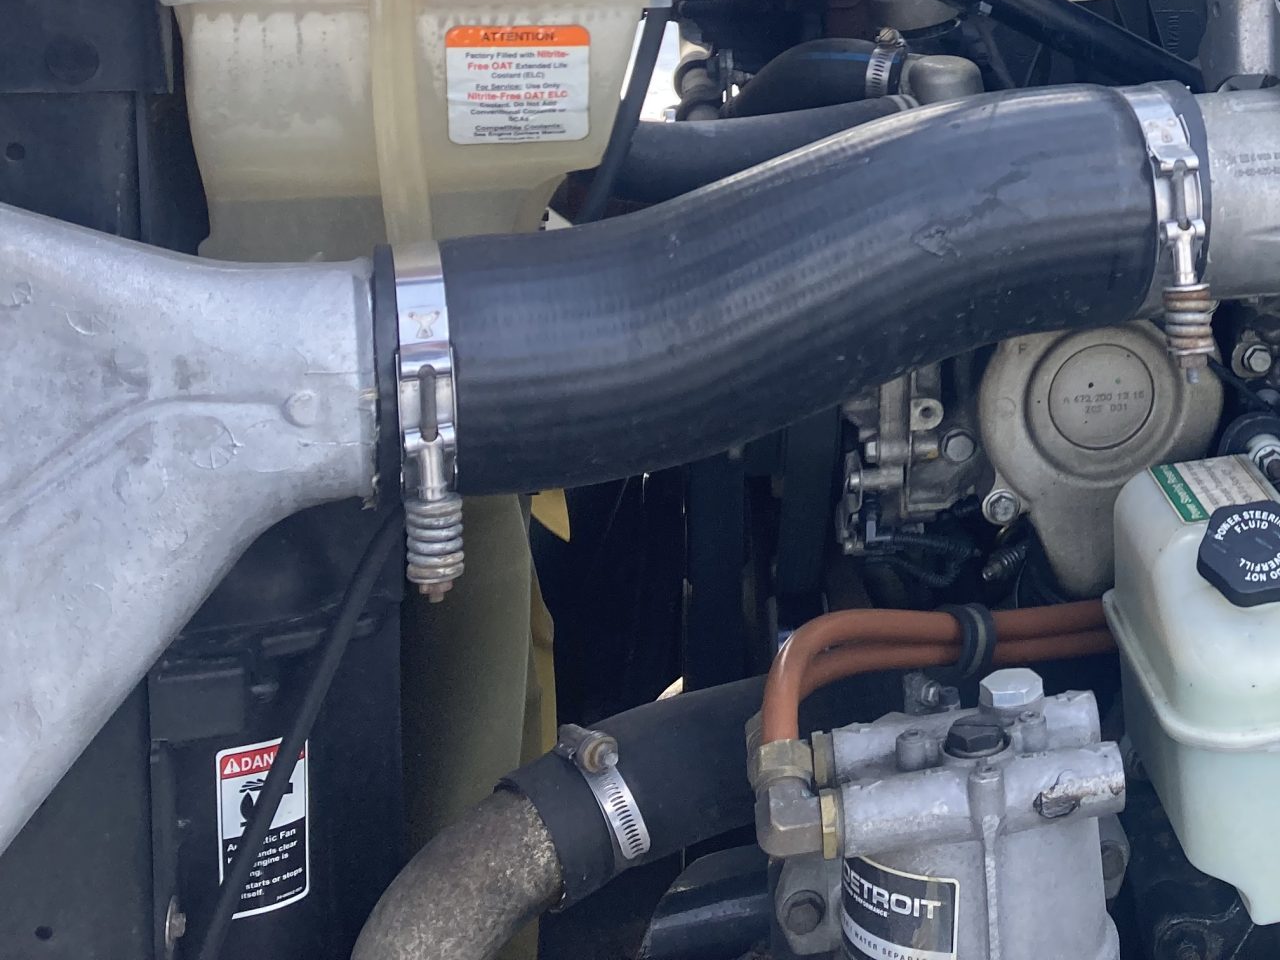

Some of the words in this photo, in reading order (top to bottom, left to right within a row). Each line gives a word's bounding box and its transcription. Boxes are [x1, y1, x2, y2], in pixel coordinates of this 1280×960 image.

[482, 32, 555, 41] ATTENTION
[465, 52, 494, 60] Factory
[536, 50, 570, 58] Nitrite-
[467, 62, 489, 70] Free
[491, 61, 513, 70] OAT
[491, 71, 521, 79] Coolant
[522, 71, 545, 79] (ELC)
[475, 83, 488, 91] For
[490, 83, 522, 91] Service:
[542, 82, 561, 90] Only
[467, 92, 521, 101] Nitrite-Free
[524, 92, 545, 100] OAT
[1214, 513, 1242, 541] POWER
[1234, 520, 1269, 535] FLUID
[1244, 571, 1268, 582] NOT
[279, 828, 296, 840] Fan
[278, 840, 298, 852] clear
[281, 852, 289, 860] is
[245, 879, 271, 890] starts
[271, 876, 281, 884] or
[282, 867, 303, 881] stops
[241, 888, 265, 900] itself.
[843, 860, 942, 919] DETROIT
